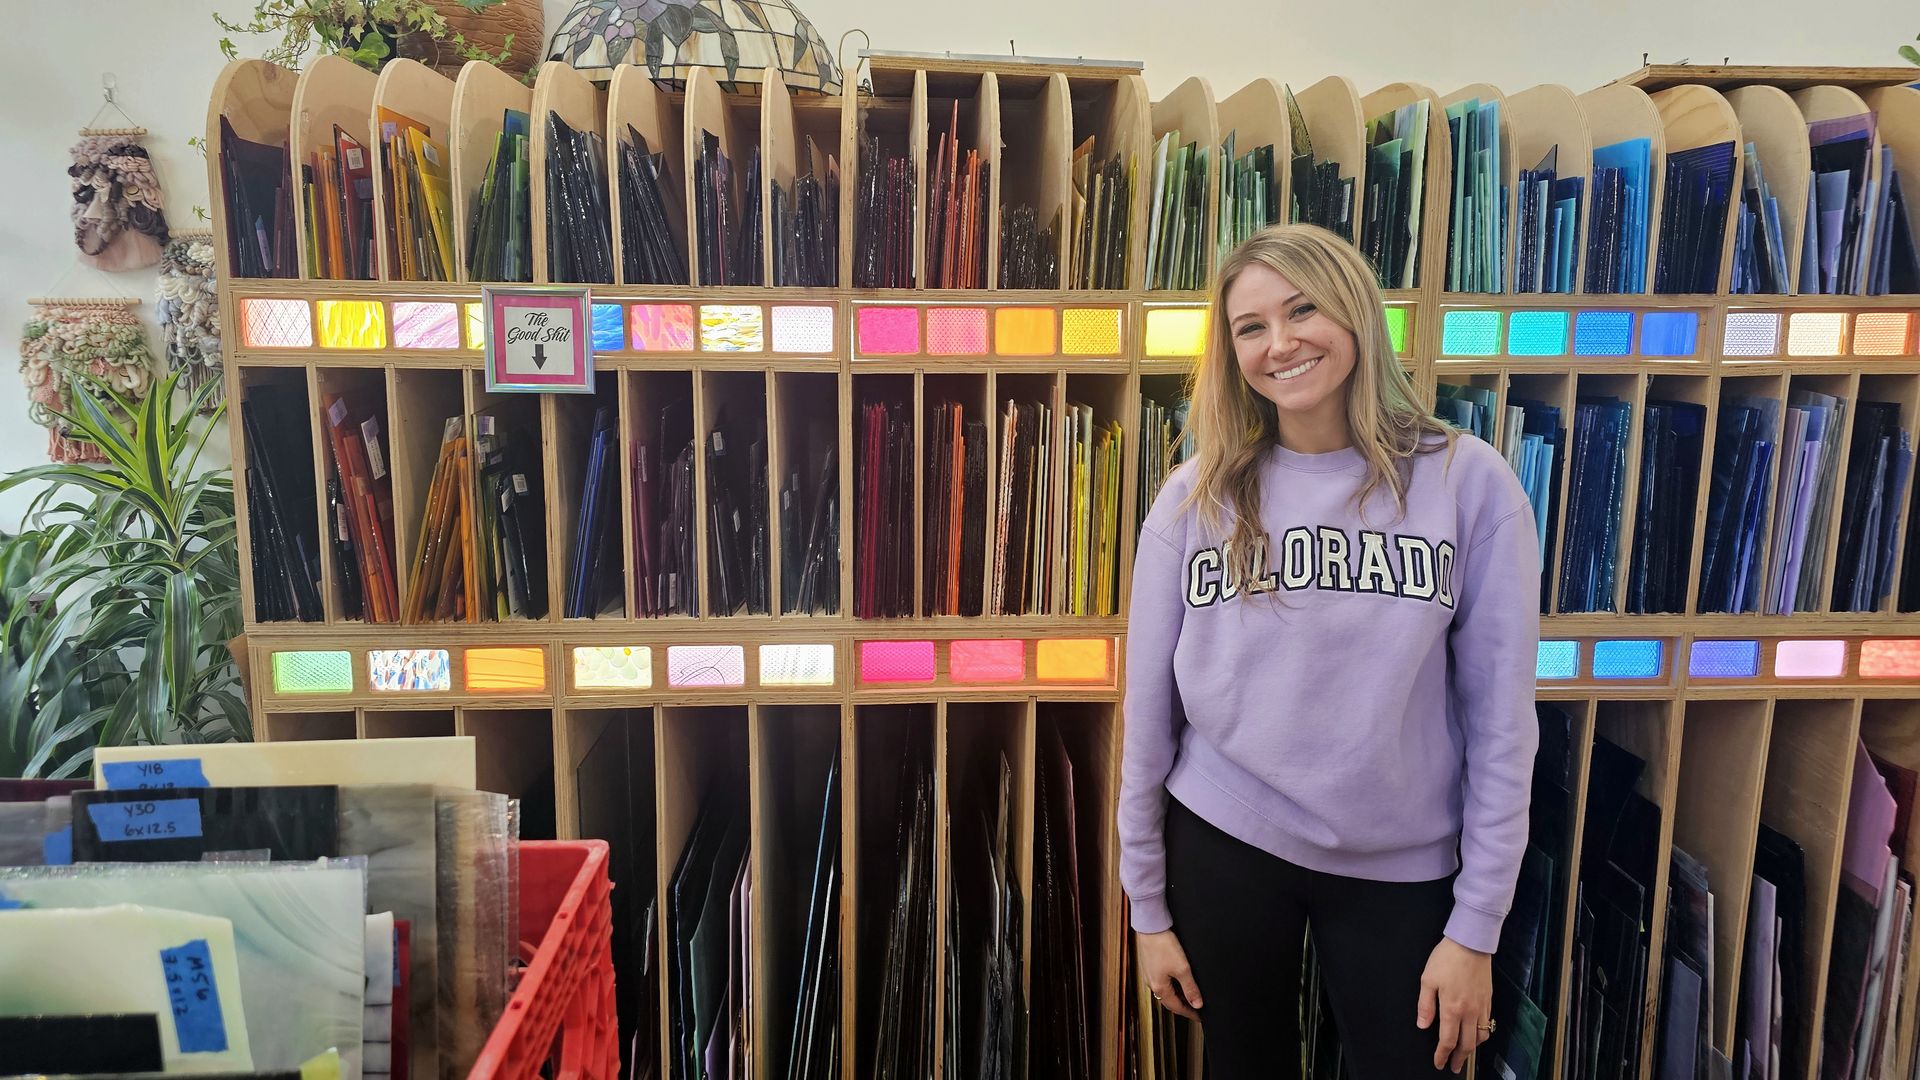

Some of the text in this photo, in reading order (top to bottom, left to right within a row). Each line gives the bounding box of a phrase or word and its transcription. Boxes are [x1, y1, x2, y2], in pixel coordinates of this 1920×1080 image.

[525, 312, 549, 327] The
[507, 326, 570, 344] Good Shit
[1187, 525, 1455, 609] COLORADO
[124, 802, 156, 817] Y30
